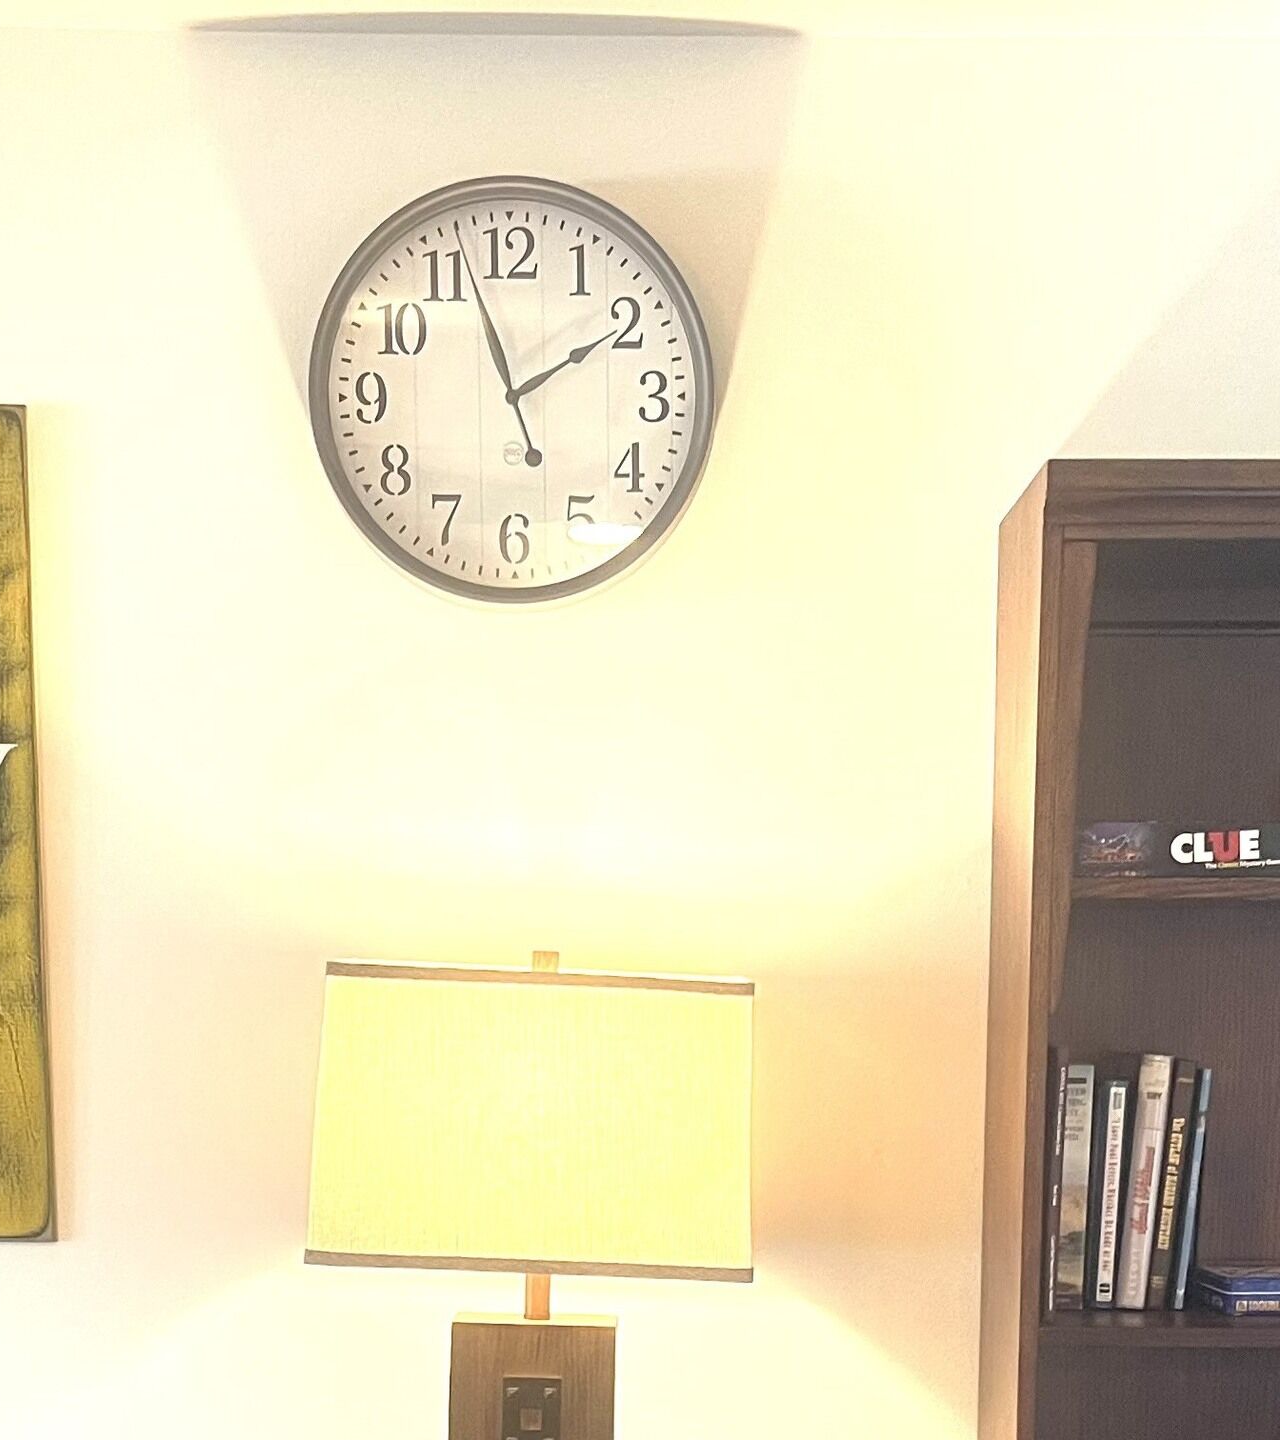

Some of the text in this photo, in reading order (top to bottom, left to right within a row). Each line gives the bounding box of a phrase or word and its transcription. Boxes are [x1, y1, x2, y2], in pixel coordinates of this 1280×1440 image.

[422, 249, 467, 301] 11
[483, 227, 538, 279] 12
[569, 244, 591, 296] 1
[377, 303, 427, 355] 10
[611, 297, 644, 349] 2
[355, 372, 387, 424] 9
[639, 371, 670, 422] 3
[381, 444, 411, 496] 8
[614, 442, 645, 492] 4
[432, 494, 462, 546] 7
[499, 513, 530, 564] 6
[1170, 829, 1260, 864] CLUE
